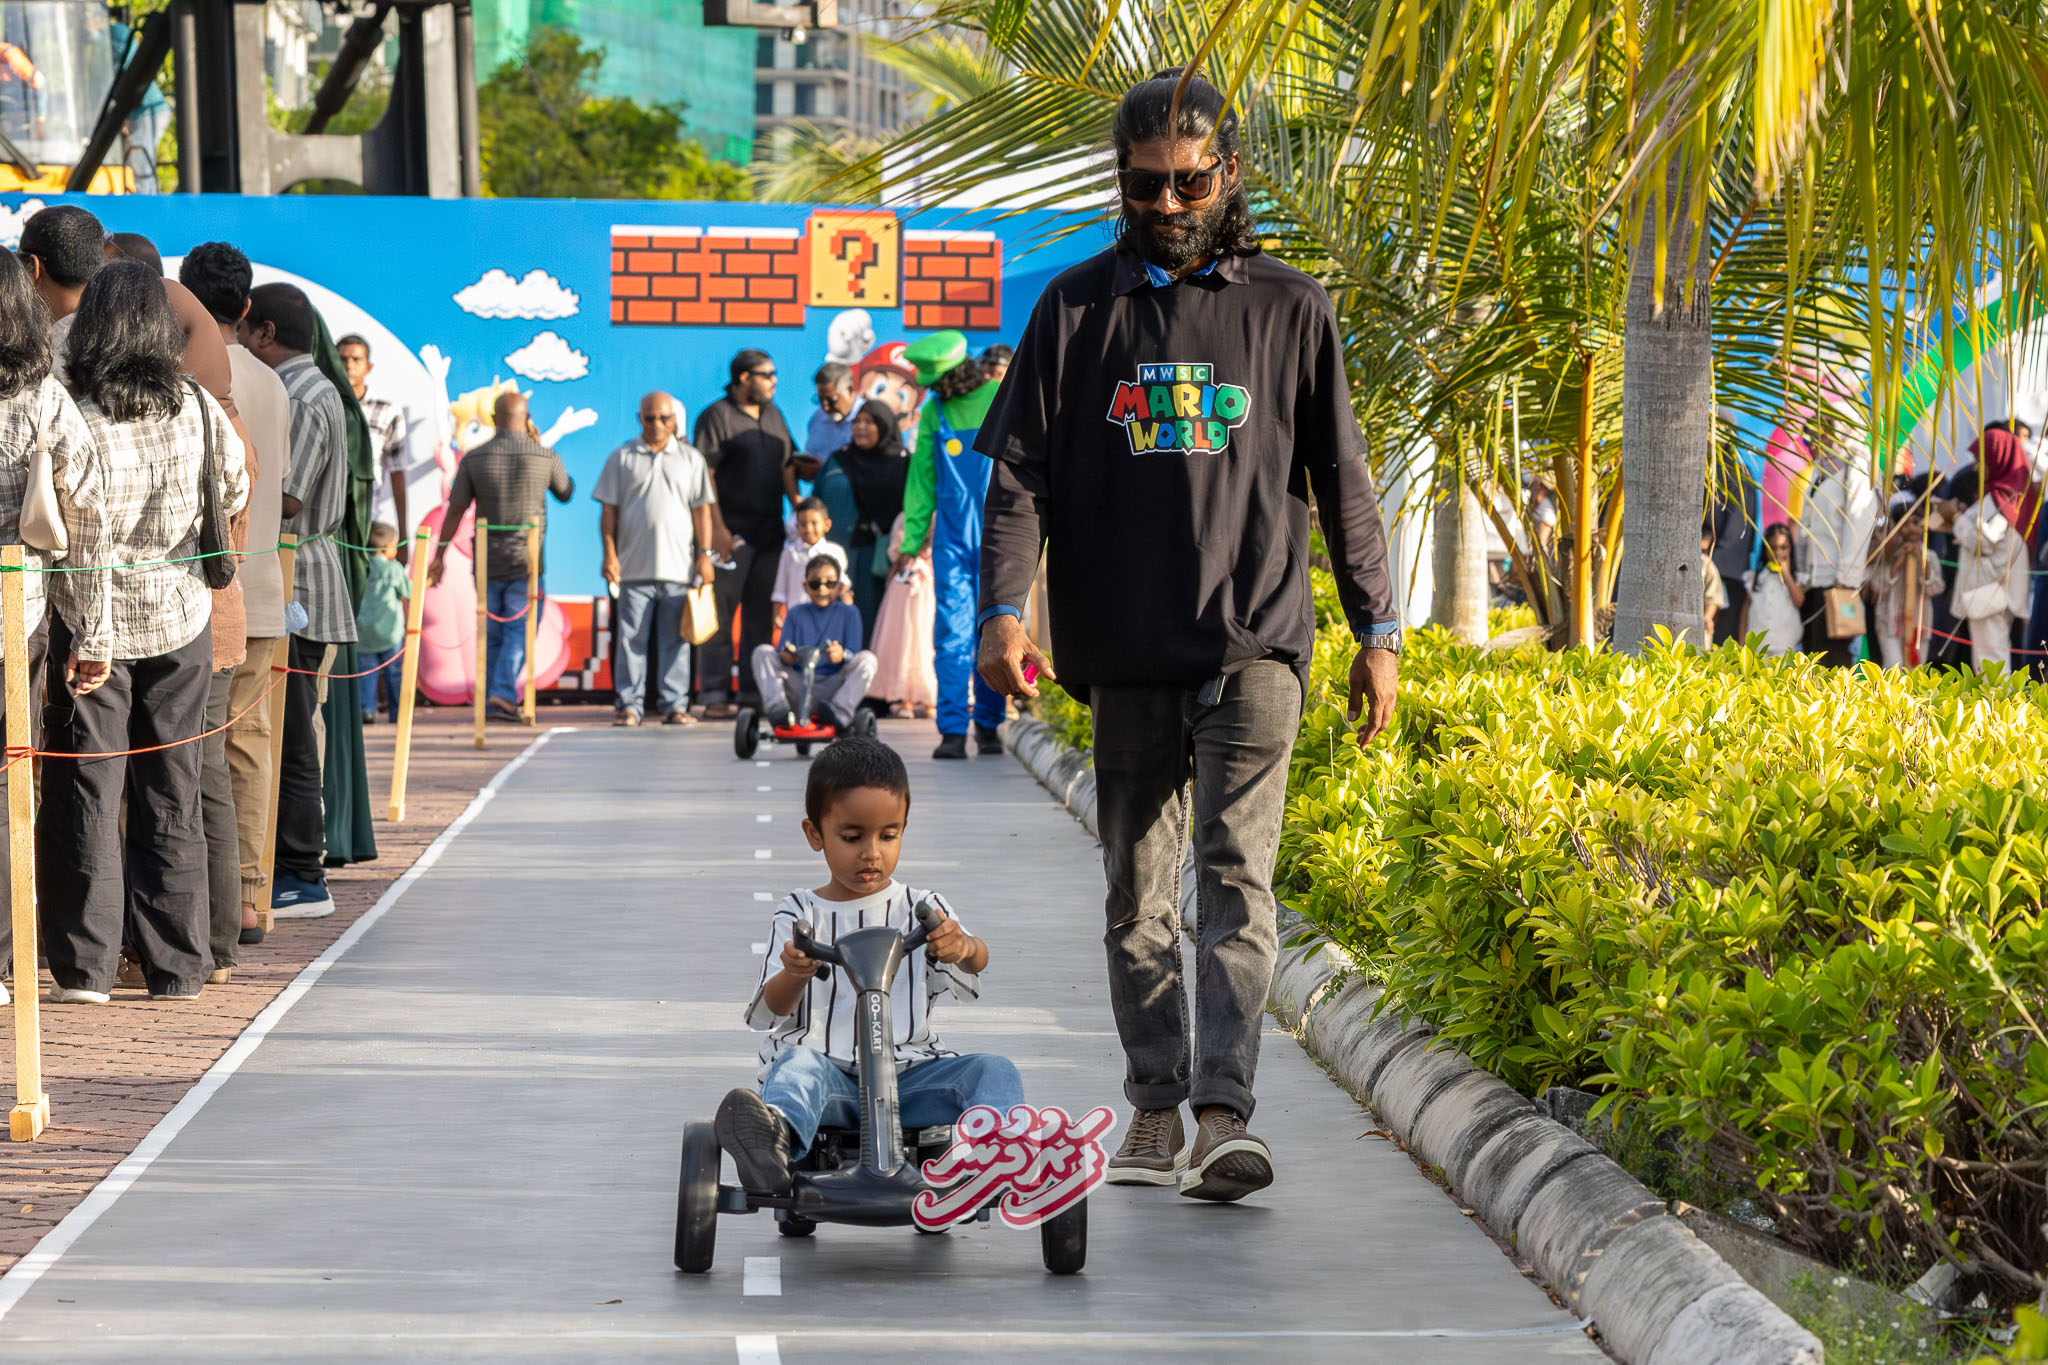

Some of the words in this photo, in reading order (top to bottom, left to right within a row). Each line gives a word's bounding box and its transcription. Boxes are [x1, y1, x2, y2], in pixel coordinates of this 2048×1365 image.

[1142, 366, 1208, 381] MWSC
[1112, 383, 1247, 420] MARIO
[1131, 420, 1227, 451] WORLD
[870, 993, 882, 1052] GO-KART
